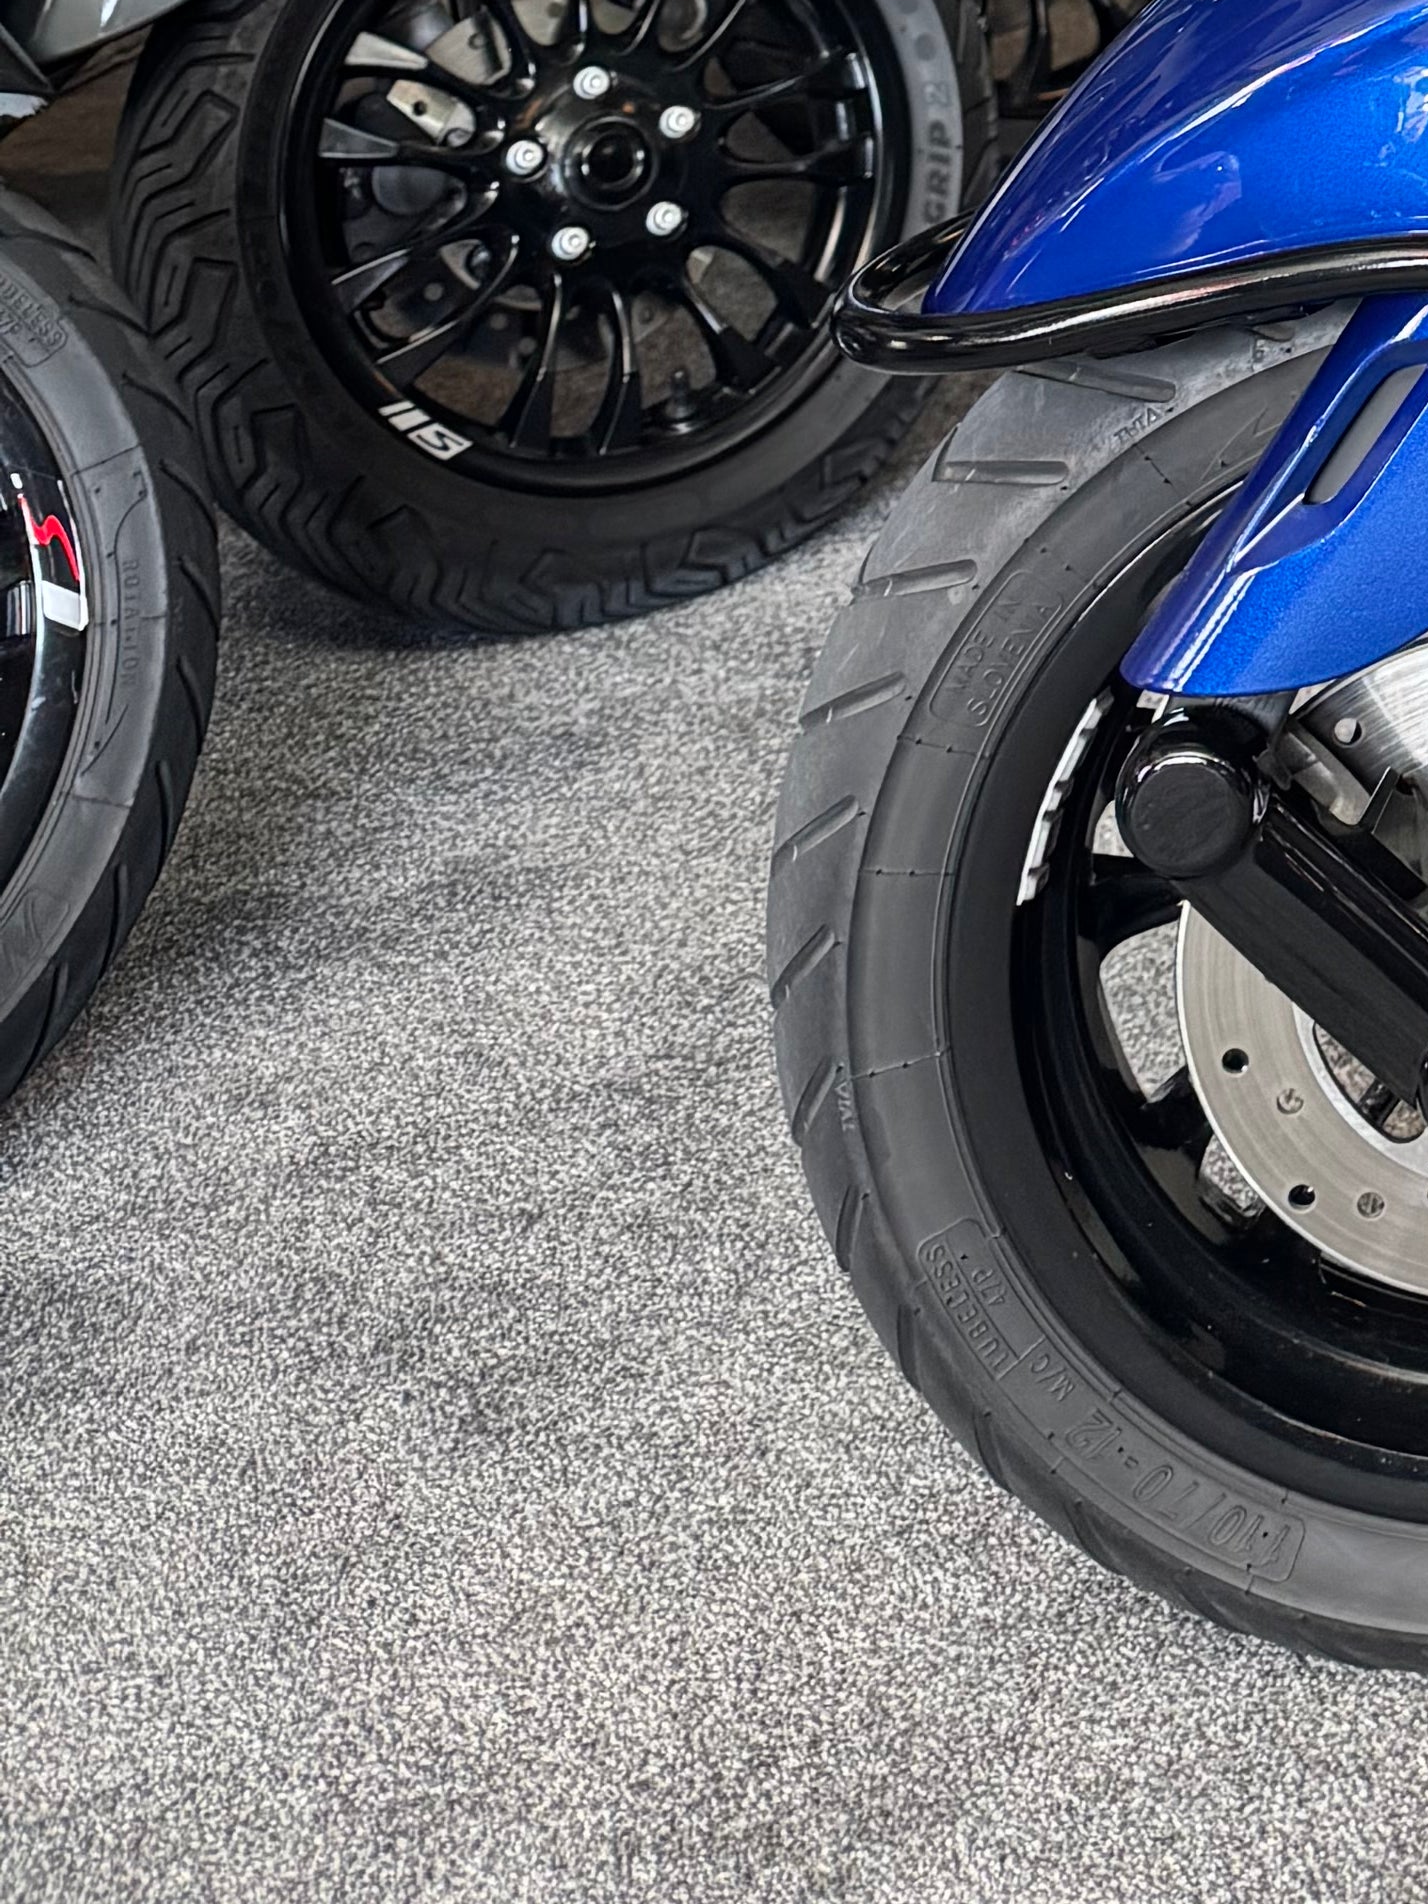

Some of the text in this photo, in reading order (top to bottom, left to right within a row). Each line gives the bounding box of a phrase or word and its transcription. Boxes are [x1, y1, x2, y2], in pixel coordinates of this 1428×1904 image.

[922, 120, 949, 224] GRIP
[120, 559, 141, 686] ROTATION
[943, 594, 1021, 691] MADE IN
[922, 1244, 1008, 1379] TUBELESS
[970, 1265, 1006, 1305] 47P
[1026, 1355, 1078, 1404] M/C
